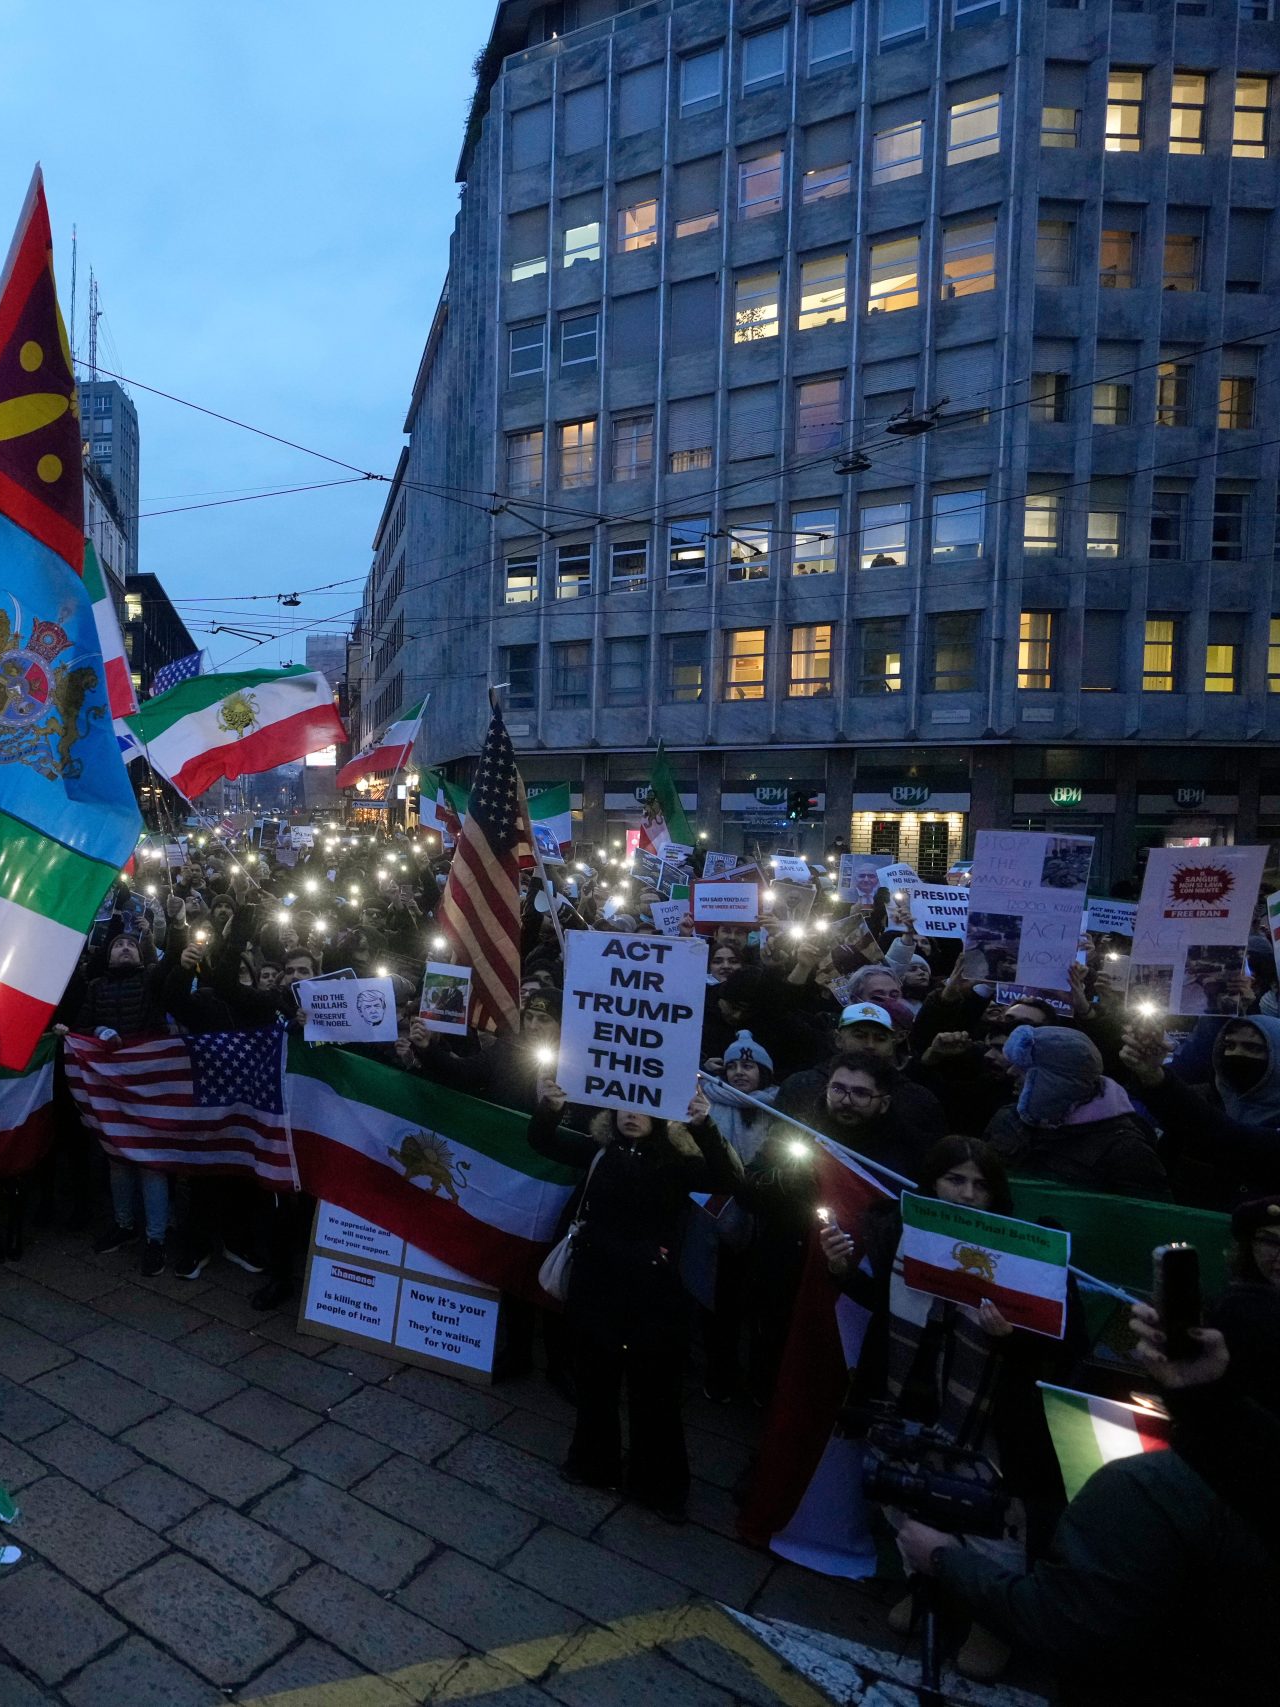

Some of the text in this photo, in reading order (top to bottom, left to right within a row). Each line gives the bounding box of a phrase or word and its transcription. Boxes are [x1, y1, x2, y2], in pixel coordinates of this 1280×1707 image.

[756, 787, 788, 800] BPM
[892, 786, 929, 800] BPM
[1053, 787, 1081, 801] BPM
[1177, 788, 1205, 801] BPM
[990, 857, 1017, 876] THE
[660, 905, 679, 914] YOUR
[925, 921, 957, 931] HELP
[601, 938, 673, 964] ACT
[610, 967, 665, 993] MR
[311, 1001, 348, 1009] MULLAHS
[330, 993, 344, 1001] THE
[572, 989, 694, 1024] TRUMP
[314, 1012, 346, 1020] DESERVE
[593, 1021, 664, 1049] END
[587, 1047, 664, 1079] THIS
[584, 1075, 662, 1108] PAIN
[328, 1216, 391, 1237] We appreciate and
[940, 1210, 951, 1221] is
[953, 1213, 971, 1226] the
[974, 1219, 1006, 1235] Final
[342, 1229, 374, 1242] will never
[346, 1240, 361, 1249] your
[362, 1244, 391, 1256] support.
[324, 1290, 378, 1312] is killing the
[410, 1289, 486, 1317] Now it's your
[316, 1302, 381, 1326] people of Iran!
[431, 1310, 460, 1327] turn!
[408, 1319, 481, 1348] They're waiting
[424, 1336, 461, 1354] for YOU
